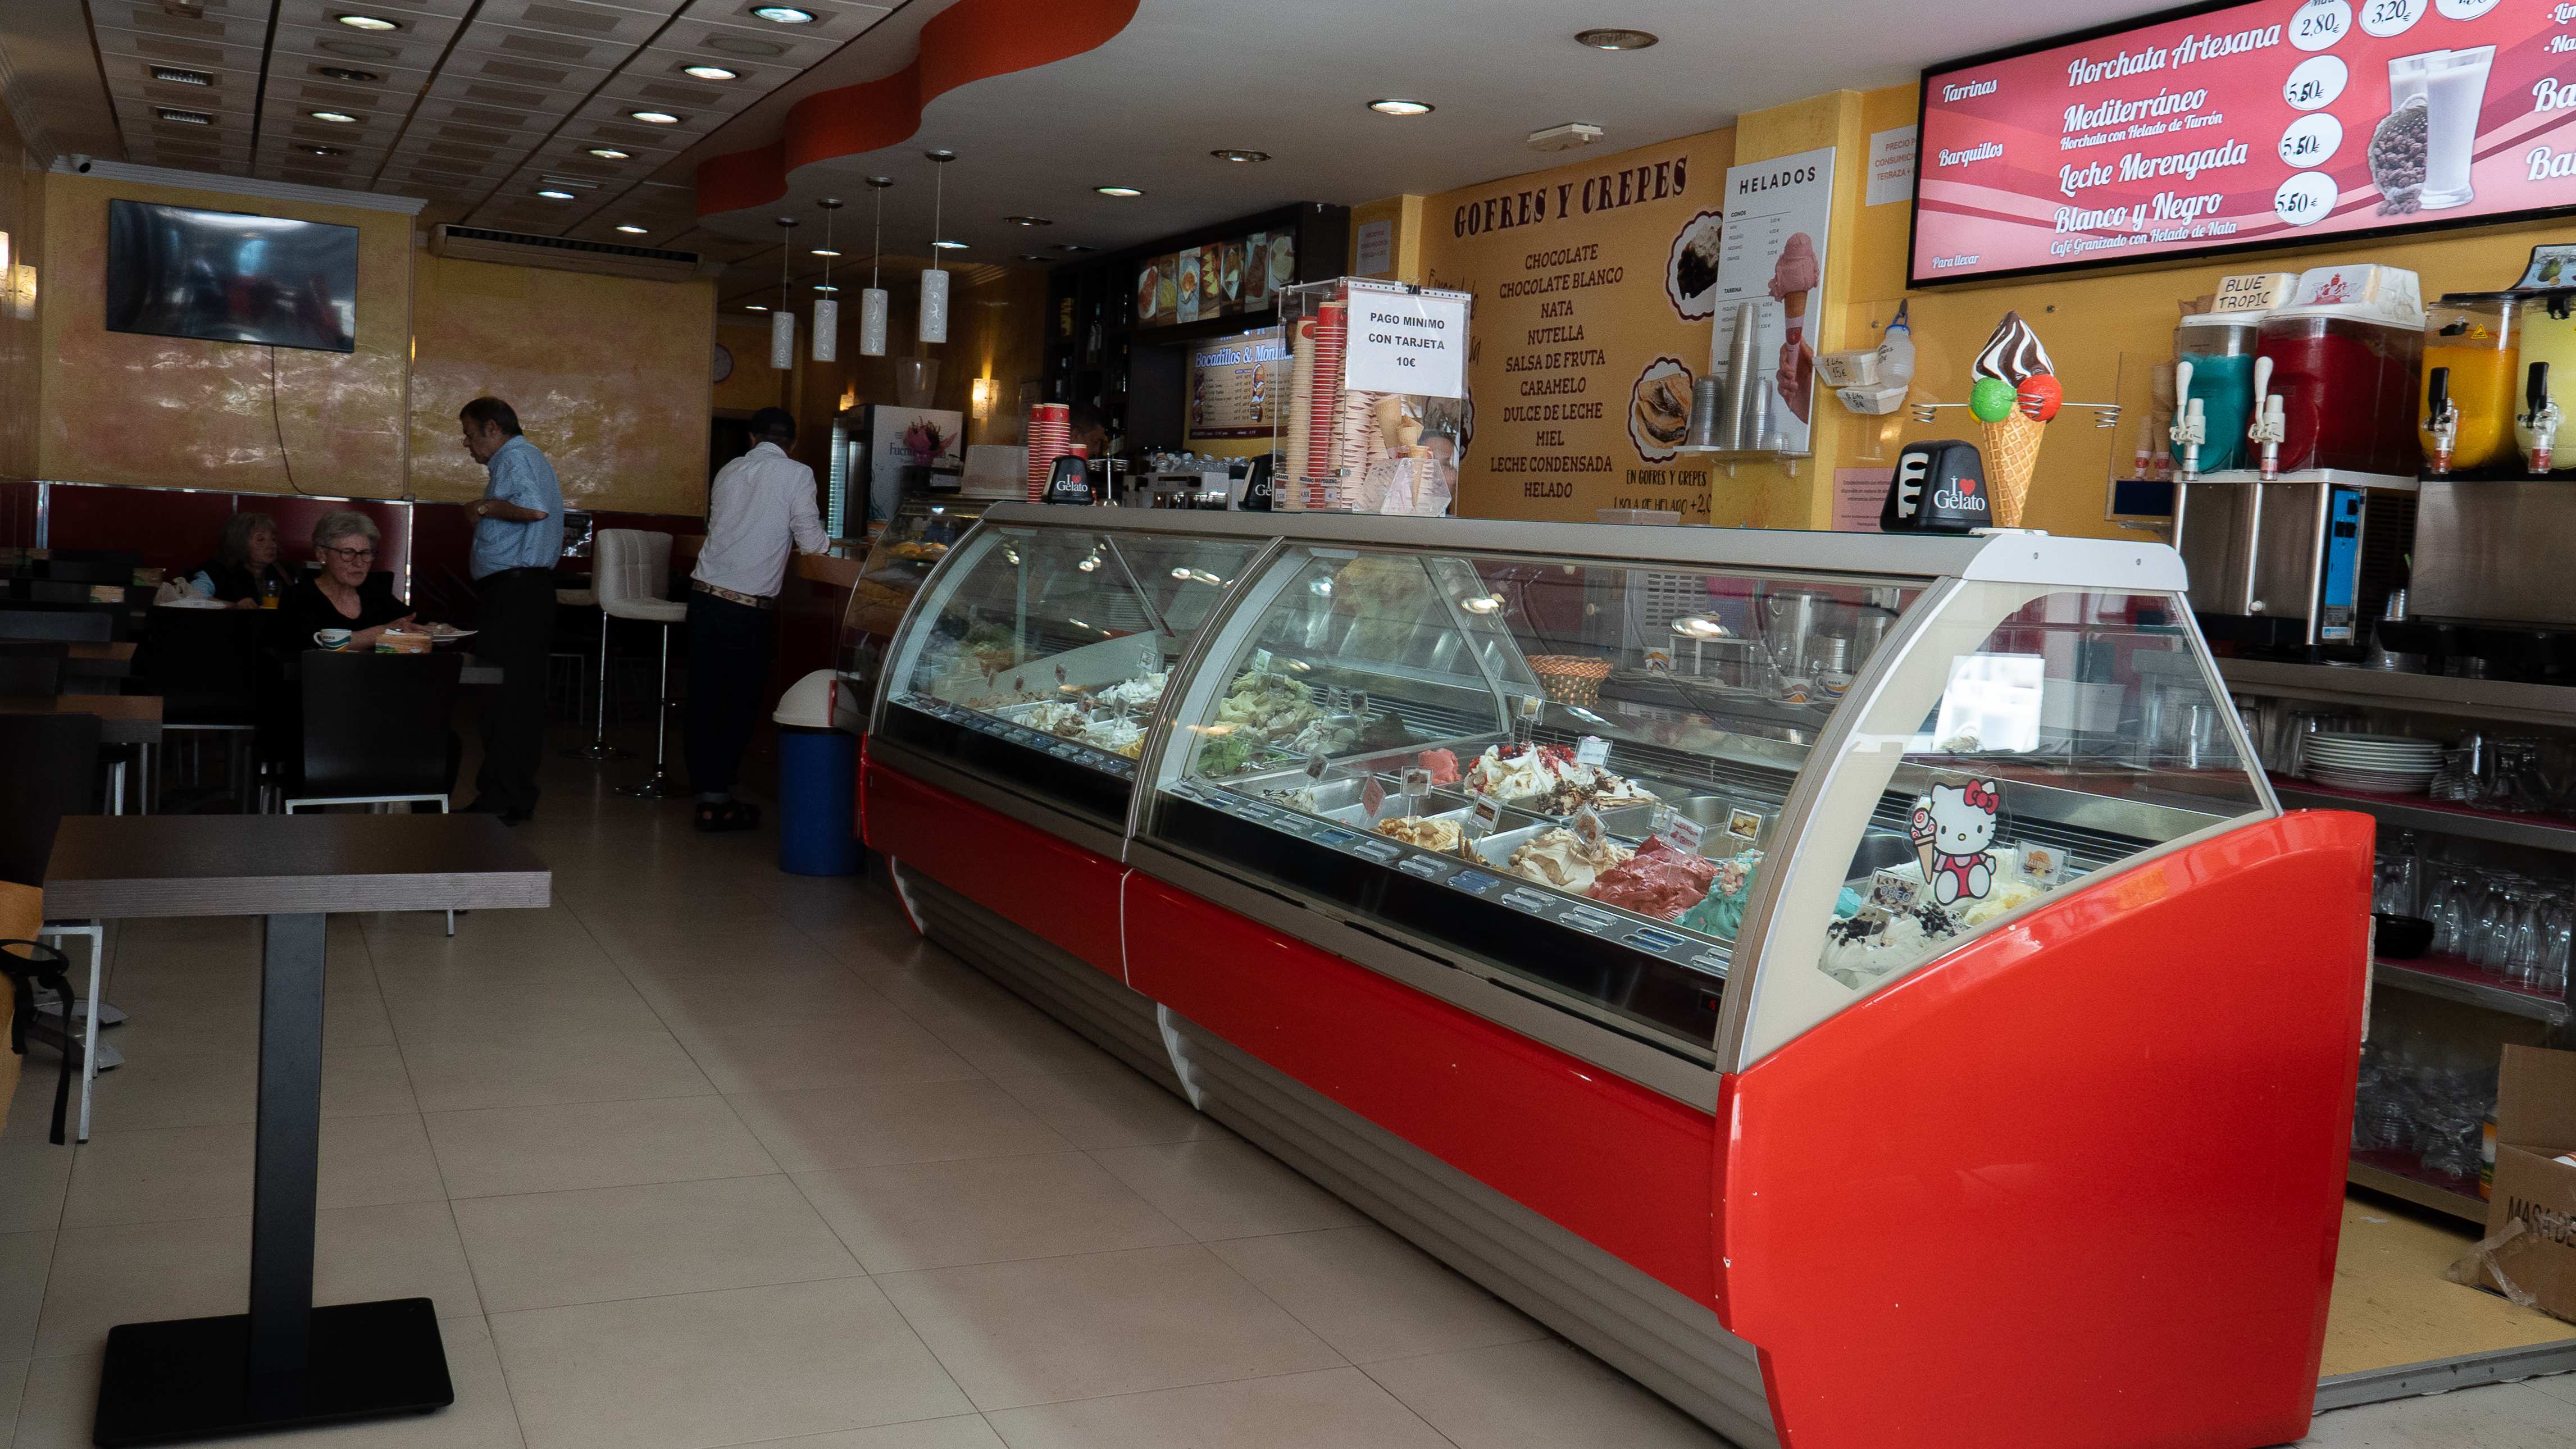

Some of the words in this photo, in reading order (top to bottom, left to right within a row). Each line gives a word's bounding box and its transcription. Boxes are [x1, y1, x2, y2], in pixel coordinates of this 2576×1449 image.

[2068, 47, 2168, 87] Horchata
[2172, 23, 2281, 69] Artesana
[1943, 78, 1997, 103] Tarrinas
[2063, 87, 2208, 133] Mediterráneo
[2060, 134, 2106, 151] Horchata
[2108, 130, 2126, 143] con
[2128, 121, 2166, 139] Helado
[2168, 119, 2182, 132] de
[2184, 110, 2223, 129] Turrón
[1885, 139, 1910, 152] PRECIO
[1938, 142, 2004, 168] Barquillos
[2059, 161, 2113, 197] Leche
[2118, 138, 2249, 181] Merengada
[1739, 166, 1815, 195] HELADOS
[1453, 186, 1548, 238] GOFRES
[1556, 183, 1573, 219] Y
[1582, 155, 1688, 214] CREPES
[2054, 206, 2128, 234] Blanco
[2132, 203, 2147, 232] y
[2152, 190, 2223, 226] Negro
[2050, 239, 2072, 257] Café
[2074, 235, 2127, 254] Granizado
[2129, 234, 2147, 245] con
[2150, 227, 2190, 243] Helado
[2192, 225, 2205, 238] de
[2208, 221, 2237, 236] Nata
[1525, 243, 1599, 270] CHOCOLATE
[1932, 255, 1953, 269] Para
[1953, 252, 1979, 267] llevar
[1499, 274, 1571, 298] CHOCOLATE
[1572, 266, 1624, 289] BLANCO
[2225, 276, 2265, 292] BLUE
[1541, 300, 1573, 318] NATA
[2219, 291, 2271, 308] TROPIC
[1371, 312, 1400, 325] PAGO
[1403, 316, 1445, 329] MINIMO
[1369, 333, 1391, 344] CON
[1395, 336, 1445, 349] TARJETA
[1527, 325, 1585, 345] NUTELLA
[1195, 348, 1241, 368] Bocadillos
[1243, 346, 1253, 363] &
[1396, 357, 1416, 367] 10€
[1506, 354, 1542, 372] SALSA
[1545, 353, 1562, 370] DE
[1564, 349, 1605, 368] FRUTA
[1521, 377, 1586, 397] CARAMELO
[1503, 405, 1542, 422] DULCE
[1544, 404, 1559, 421] DE
[1562, 402, 1603, 420] LECHE
[1536, 430, 1564, 446] MIEL
[1490, 457, 1527, 472] LECHE
[1530, 455, 1613, 472] CONDENSADA
[1056, 481, 1088, 492] Gelato
[1626, 470, 1636, 485] EN
[1639, 470, 1666, 485] GOFRES
[1669, 471, 1676, 486] Y
[1678, 470, 1707, 486] CREPES
[1950, 476, 1958, 496] I
[1524, 482, 1572, 498] HELADO
[1933, 490, 1986, 511] Gelato
[1880, 886, 1910, 902] OREO
